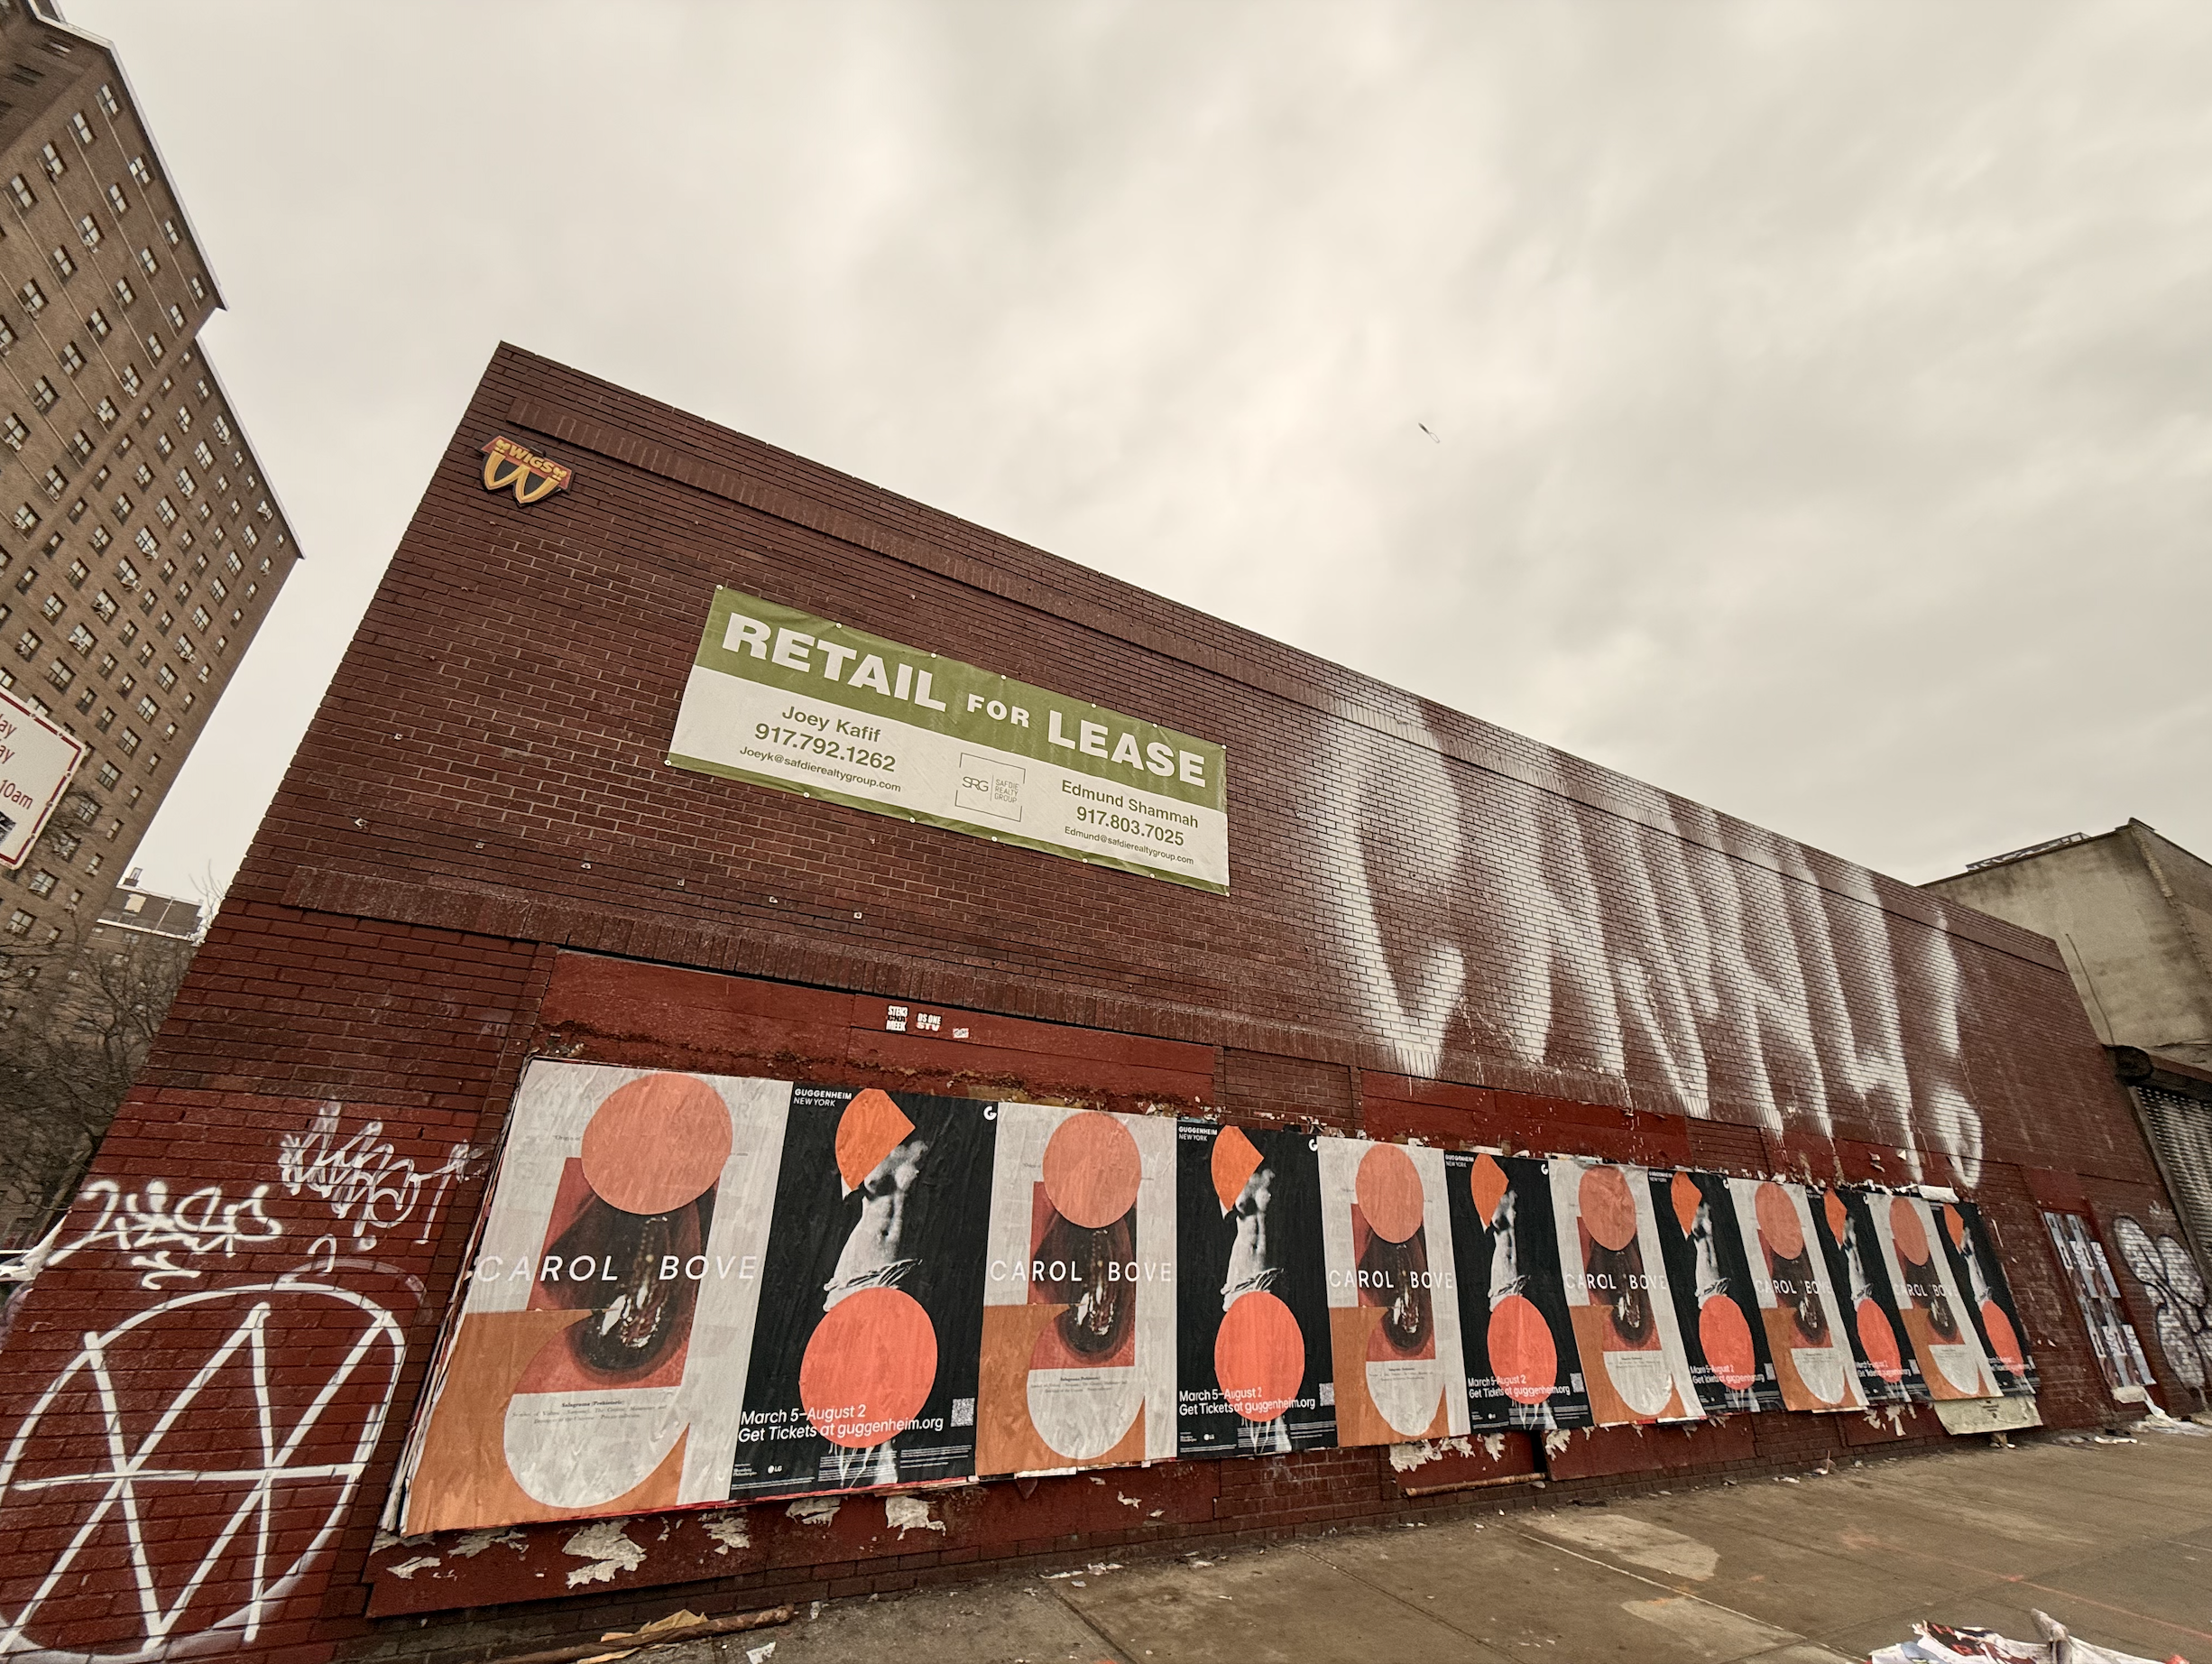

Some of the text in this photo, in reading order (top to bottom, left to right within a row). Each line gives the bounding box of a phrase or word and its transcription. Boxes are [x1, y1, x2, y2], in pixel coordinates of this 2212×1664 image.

[508, 445, 555, 473] WIGS
[722, 612, 1205, 788] RETAIL FOR LEASE
[781, 706, 880, 742] Joey Kafif
[755, 723, 896, 772] 917.792.1262
[740, 746, 901, 792] Joeyk@safdierealtygroup.com
[963, 776, 989, 791] SRG
[994, 786, 1018, 797] REALTY
[995, 779, 1019, 790] SAFDIE
[994, 793, 1017, 803] GROUP
[1062, 780, 1198, 828] Edmund Shammah
[1076, 806, 1184, 846] 917.803.7025
[1065, 826, 1194, 864] Edmund@safdierealtygroup.com
[793, 1096, 836, 1107] NEW YORK
[794, 1088, 853, 1100] GUGGENHEIM
[983, 1105, 997, 1121] G
[1178, 1126, 1217, 1135] GUGGENHEIM
[1308, 1138, 1318, 1151] G
[475, 1254, 758, 1282] CAROL BOVE
[990, 1260, 1172, 1281] CAROL BOVE
[1329, 1270, 1452, 1290] CAROL BOVE
[1565, 1273, 1667, 1290] CAROL BOVE
[1468, 1377, 1490, 1387] March
[1520, 1374, 1526, 1383] 2
[1179, 1390, 1211, 1402] March
[1258, 1387, 1262, 1398] 2
[1469, 1389, 1482, 1399] Get
[1505, 1387, 1513, 1395] at
[741, 1409, 787, 1426] March
[857, 1404, 866, 1418] 2
[1179, 1397, 1315, 1416] Get Tickets at guggenheim.org
[738, 1418, 944, 1443] Get Tickets at guggenheim.org
